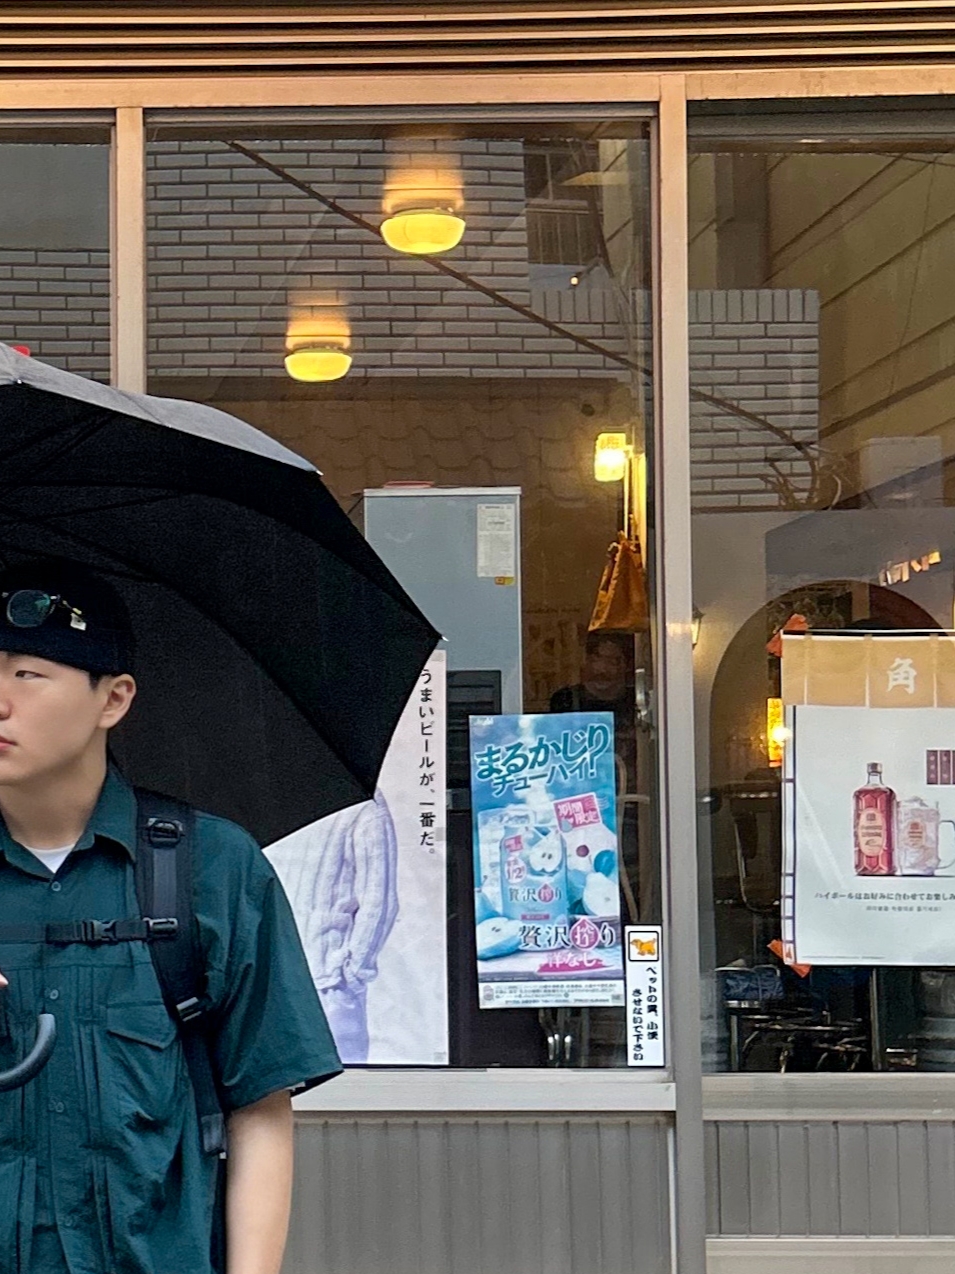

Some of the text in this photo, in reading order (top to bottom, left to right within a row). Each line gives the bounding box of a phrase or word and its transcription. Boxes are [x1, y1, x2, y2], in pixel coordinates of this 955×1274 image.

[886, 657, 917, 694] 角
[419, 669, 435, 854] うまいビールが、一番だ。
[475, 723, 610, 779] まるかじり
